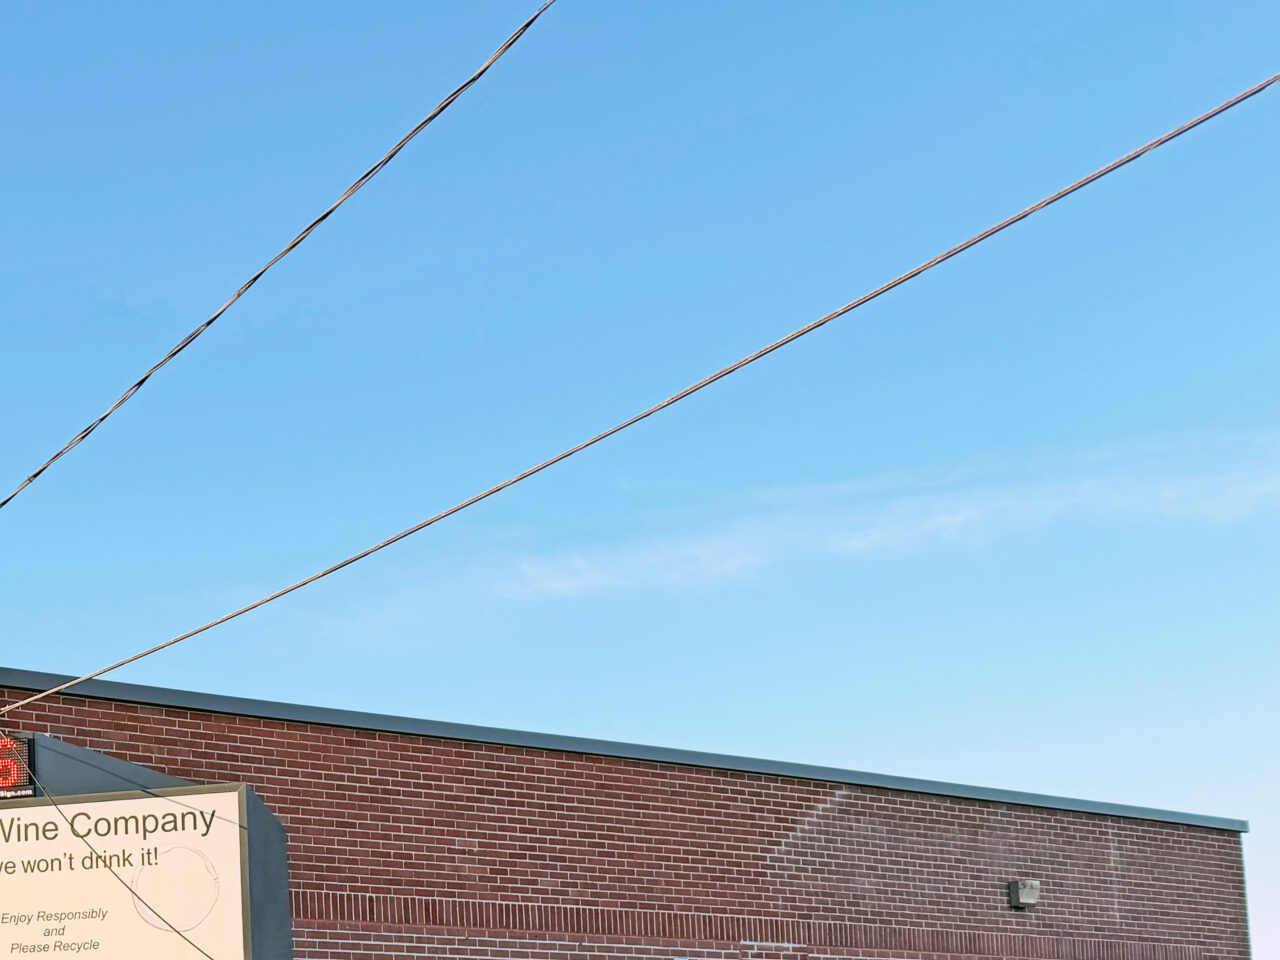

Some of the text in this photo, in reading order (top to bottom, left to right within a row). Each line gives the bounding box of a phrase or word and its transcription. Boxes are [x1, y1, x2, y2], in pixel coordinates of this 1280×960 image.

[70, 809, 216, 840] Company
[21, 852, 75, 874] won’t
[81, 847, 134, 870] drink
[141, 847, 159, 867] it!
[1, 908, 108, 925] Enjoy Responsibly
[43, 925, 66, 937] and
[10, 939, 100, 954] Please Recycle
